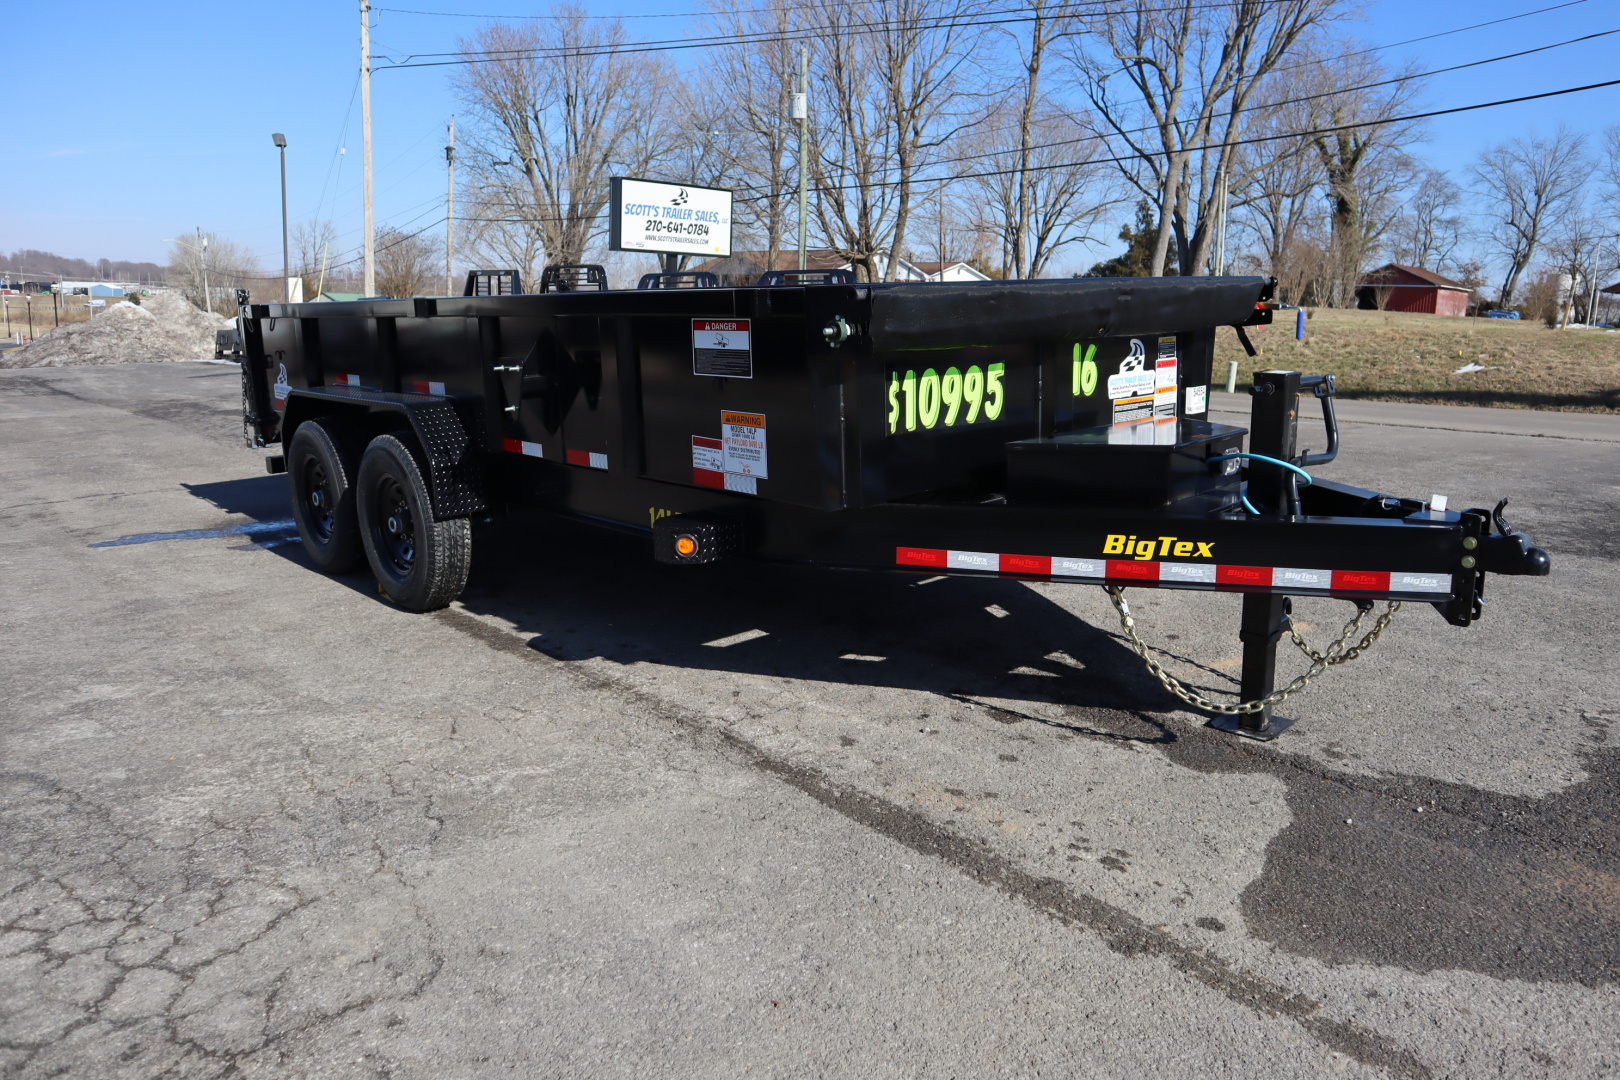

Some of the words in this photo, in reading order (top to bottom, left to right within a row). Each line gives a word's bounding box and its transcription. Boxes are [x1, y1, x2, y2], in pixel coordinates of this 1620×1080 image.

[625, 203, 659, 217] SCOTT'S
[662, 207, 693, 220] TRAILER
[695, 210, 719, 224] SALES,
[645, 220, 709, 236] 270-641-0784
[1073, 343, 1098, 396] 16
[889, 362, 1005, 434] $10995
[731, 415, 761, 426] WARNING
[731, 426, 745, 434] MODEL
[1102, 534, 1215, 560] BigTex
[958, 554, 987, 563] BigTex
[1062, 561, 1094, 570] BigTex
[1171, 566, 1203, 575] BigTex
[1284, 572, 1318, 580] BigTex
[1403, 576, 1438, 585] BigTex
